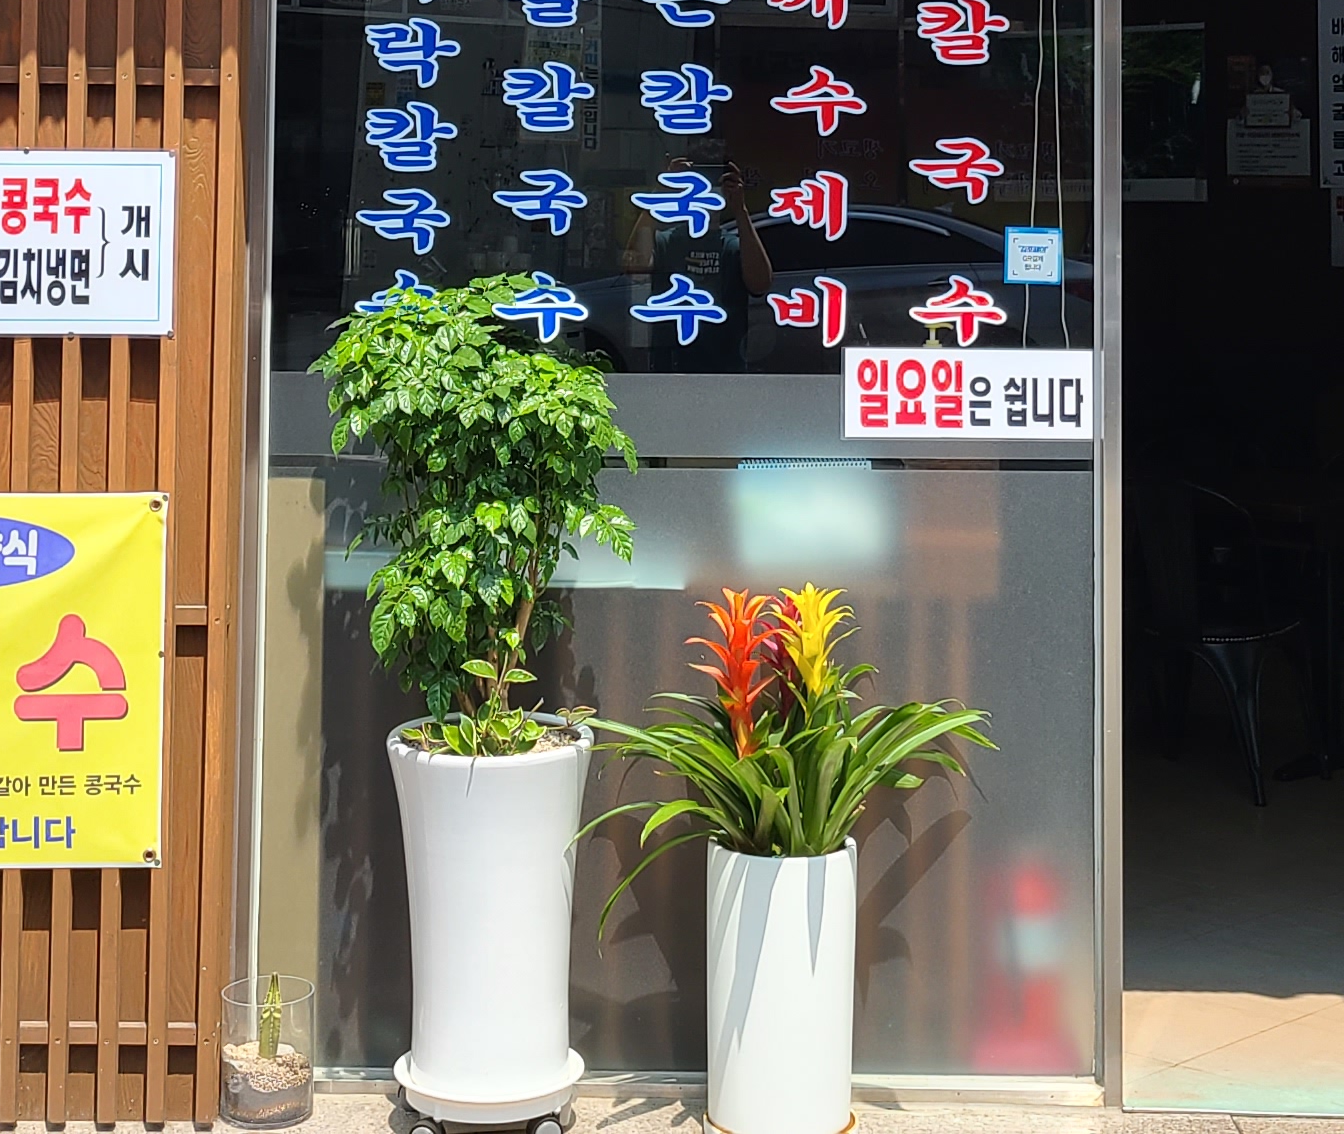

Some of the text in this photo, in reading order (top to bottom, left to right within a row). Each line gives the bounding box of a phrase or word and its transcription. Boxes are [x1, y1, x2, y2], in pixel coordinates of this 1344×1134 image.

[1, 177, 92, 235] 콩국수
[856, 357, 1084, 429] 일요일은 쉽니다
[38, 775, 77, 797] 만든
[83, 774, 142, 797] 콩국수
